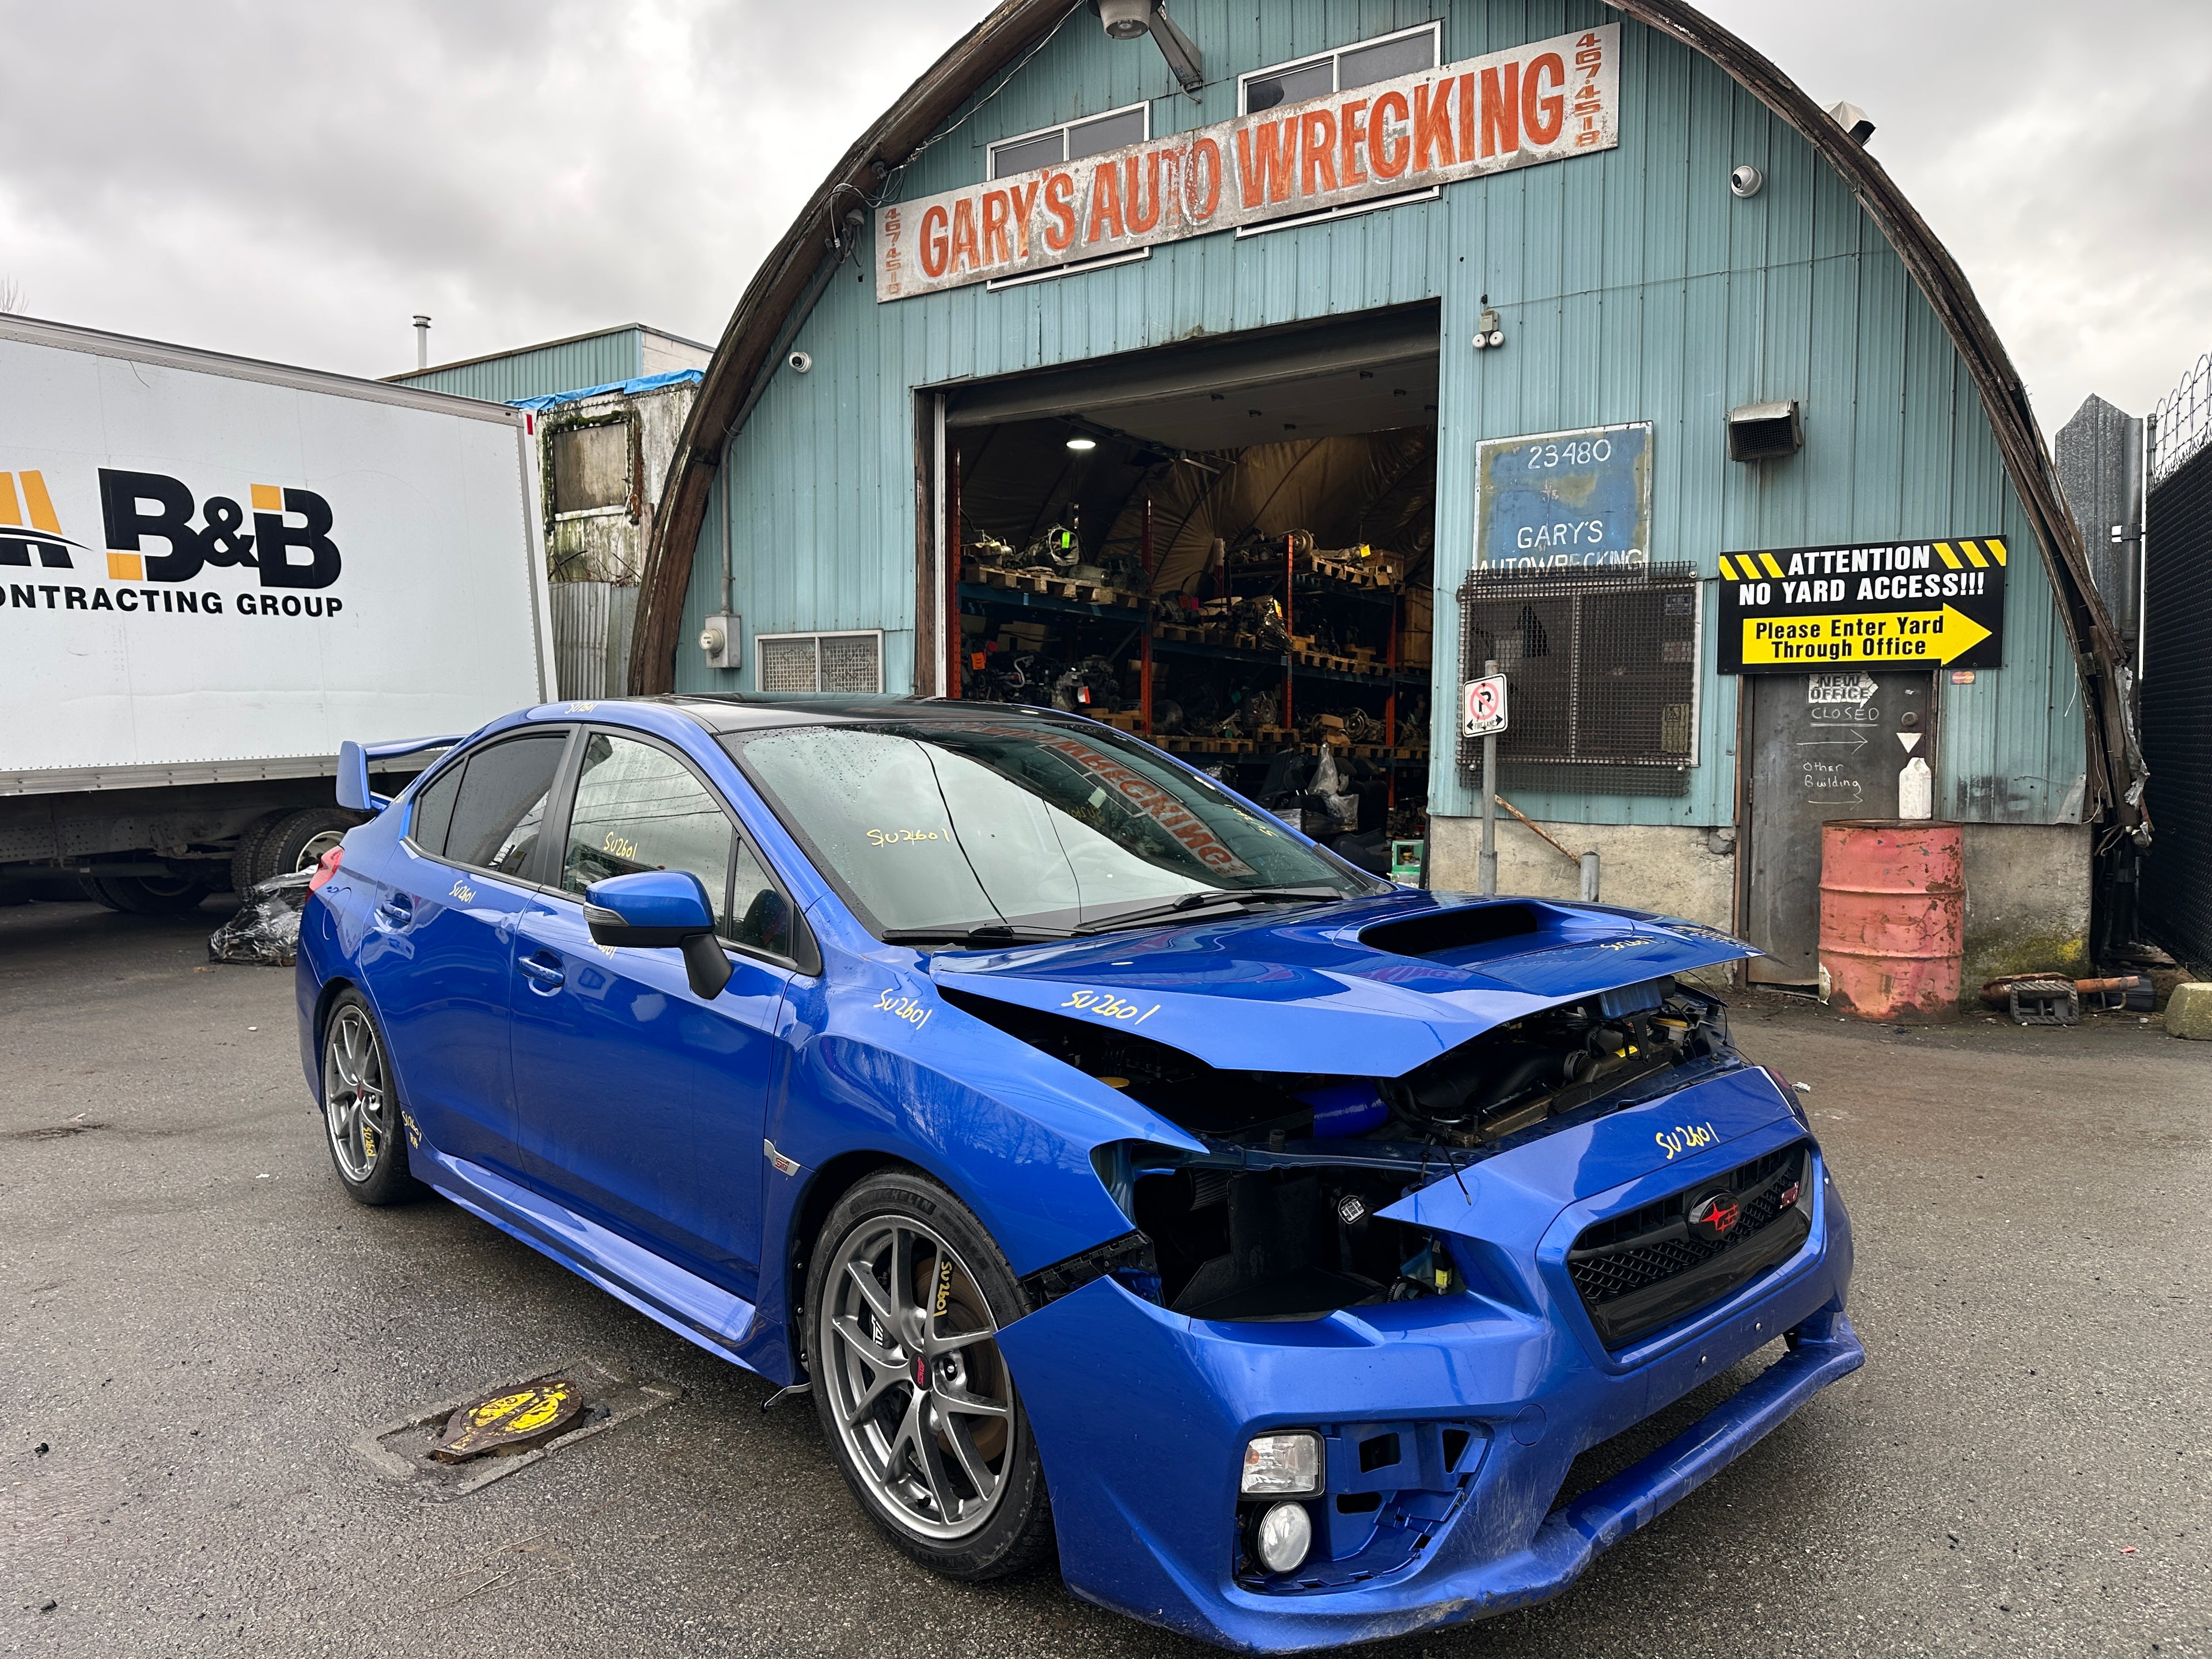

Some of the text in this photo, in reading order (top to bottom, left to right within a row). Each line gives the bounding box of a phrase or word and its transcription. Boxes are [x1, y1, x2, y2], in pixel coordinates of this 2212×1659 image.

[919, 52, 1565, 278] GARY'S AUTO WRECKING
[1528, 439, 1611, 469] 23480
[97, 468, 342, 589] B&B
[1517, 520, 1603, 549] GARY'S
[1787, 545, 1930, 575] ATTENTION
[0, 584, 343, 618] NTRACTING GROUP
[1739, 571, 1984, 605] NO YARD ACCESS!!!
[1756, 616, 1944, 639] Please Enter Yard
[1771, 637, 1926, 660] Through Office
[1810, 687, 1870, 699] OFFICE
[1819, 676, 1862, 687] NEW
[1811, 706, 1879, 720] CLOSED
[1805, 774, 1862, 795] Building
[603, 831, 638, 861] SU2601
[866, 828, 950, 848] SU2601
[449, 880, 475, 904] SU2601
[873, 988, 933, 1030] SU2601
[1061, 990, 1161, 1025] SU2601
[1656, 1122, 1720, 1160] SU2601
[933, 1260, 953, 1317] SU2601
